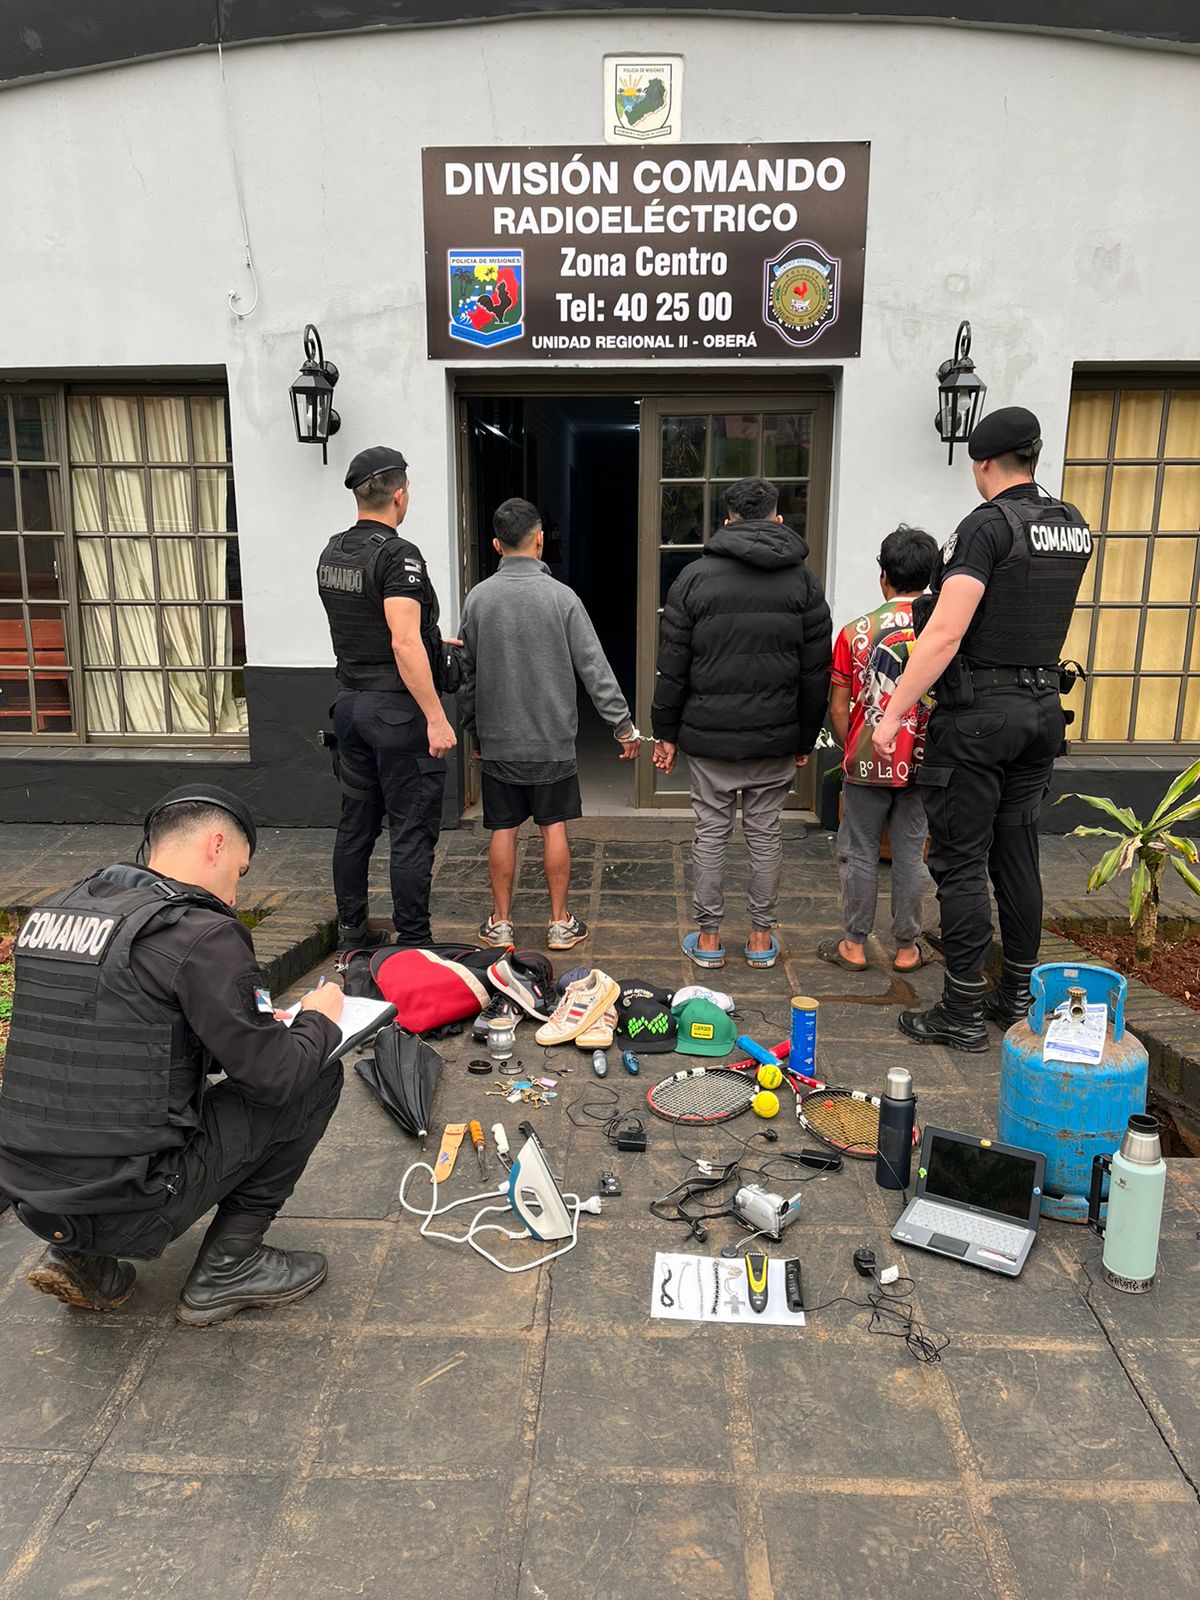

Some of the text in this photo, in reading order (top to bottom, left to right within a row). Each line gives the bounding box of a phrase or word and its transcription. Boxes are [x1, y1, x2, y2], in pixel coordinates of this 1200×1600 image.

[445, 153, 846, 196] DIVISIÓN COMANDO
[493, 198, 798, 235] RADIOELÉCTRICO
[560, 246, 728, 277] Zona Centro
[555, 291, 733, 322] Tel: 40 25 00
[531, 335, 591, 349] UNIDAD
[595, 334, 674, 349] REGIONAL
[678, 334, 688, 348] II
[703, 331, 758, 348] OBERÁ
[1030, 524, 1092, 554] COMANDO
[319, 564, 363, 594] COMANDO
[877, 761, 893, 778] La
[17, 912, 115, 956] COMANDO
